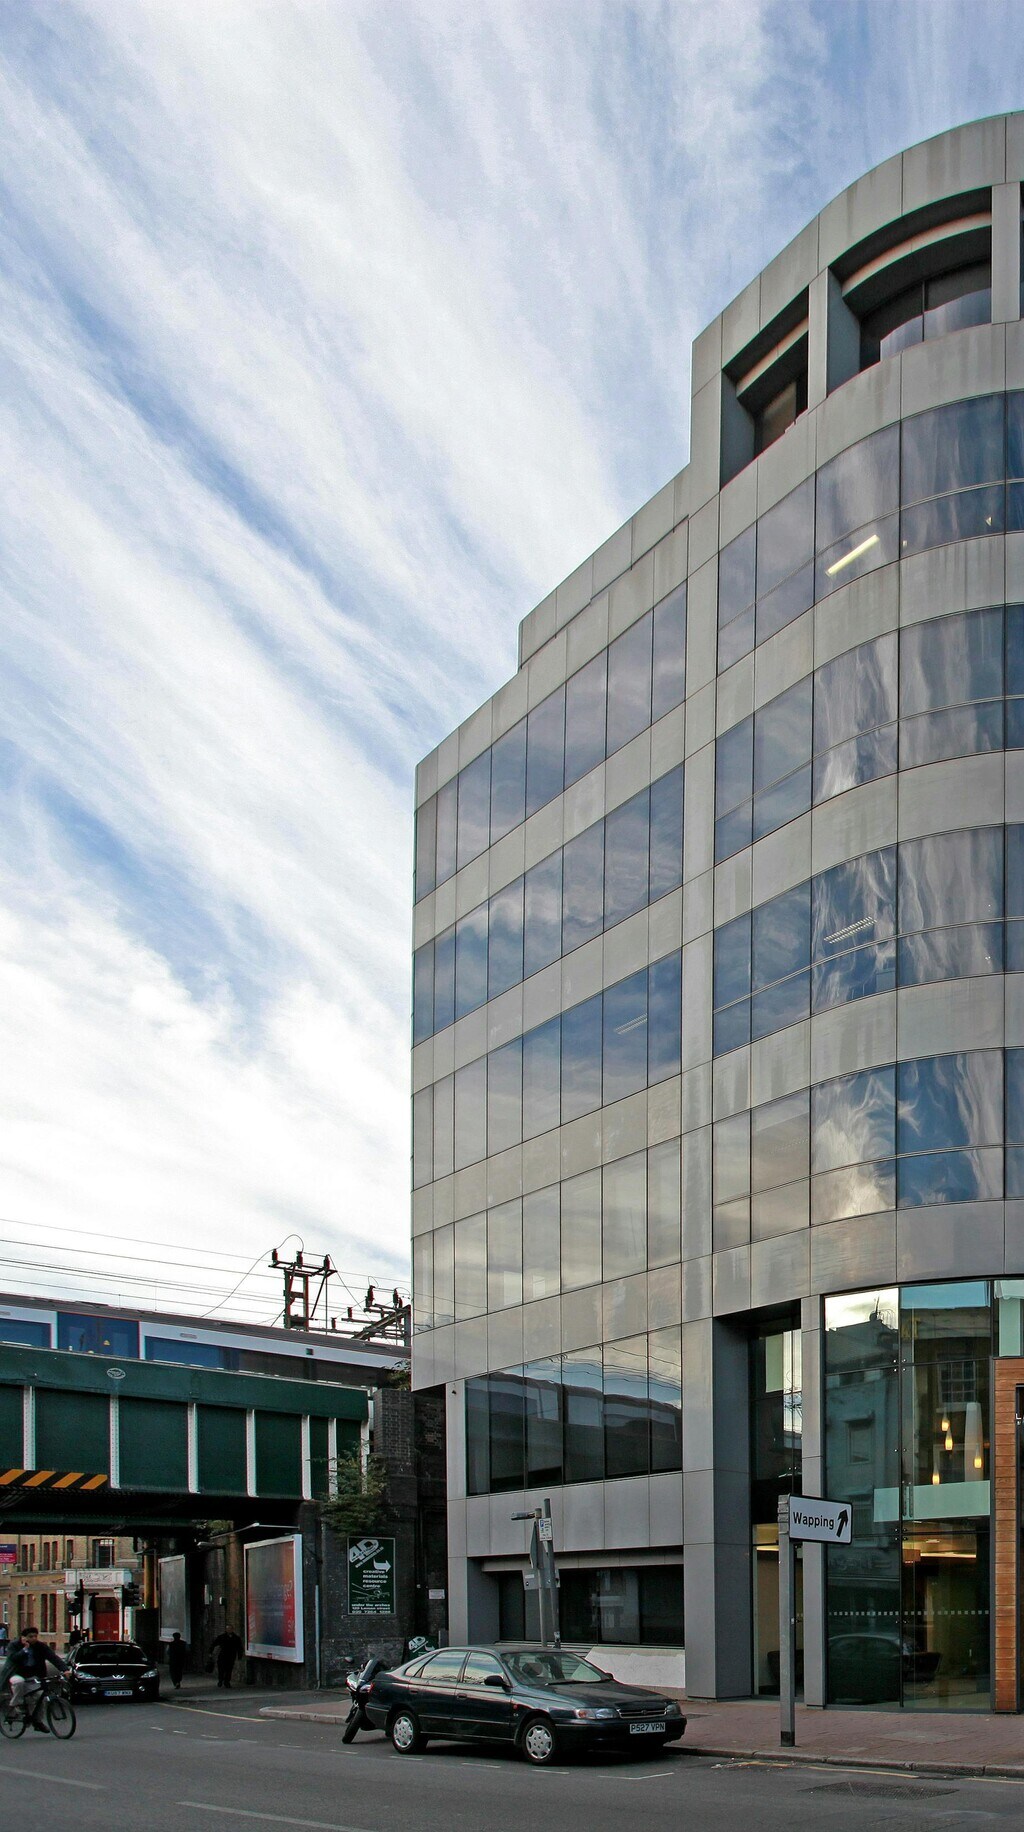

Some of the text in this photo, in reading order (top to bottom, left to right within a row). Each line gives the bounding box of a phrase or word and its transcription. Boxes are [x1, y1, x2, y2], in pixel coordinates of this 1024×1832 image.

[793, 1511, 834, 1530] Wapping
[349, 1539, 379, 1562] 4D
[409, 1636, 426, 1650] 4D
[631, 1723, 665, 1732] P527 VPN
